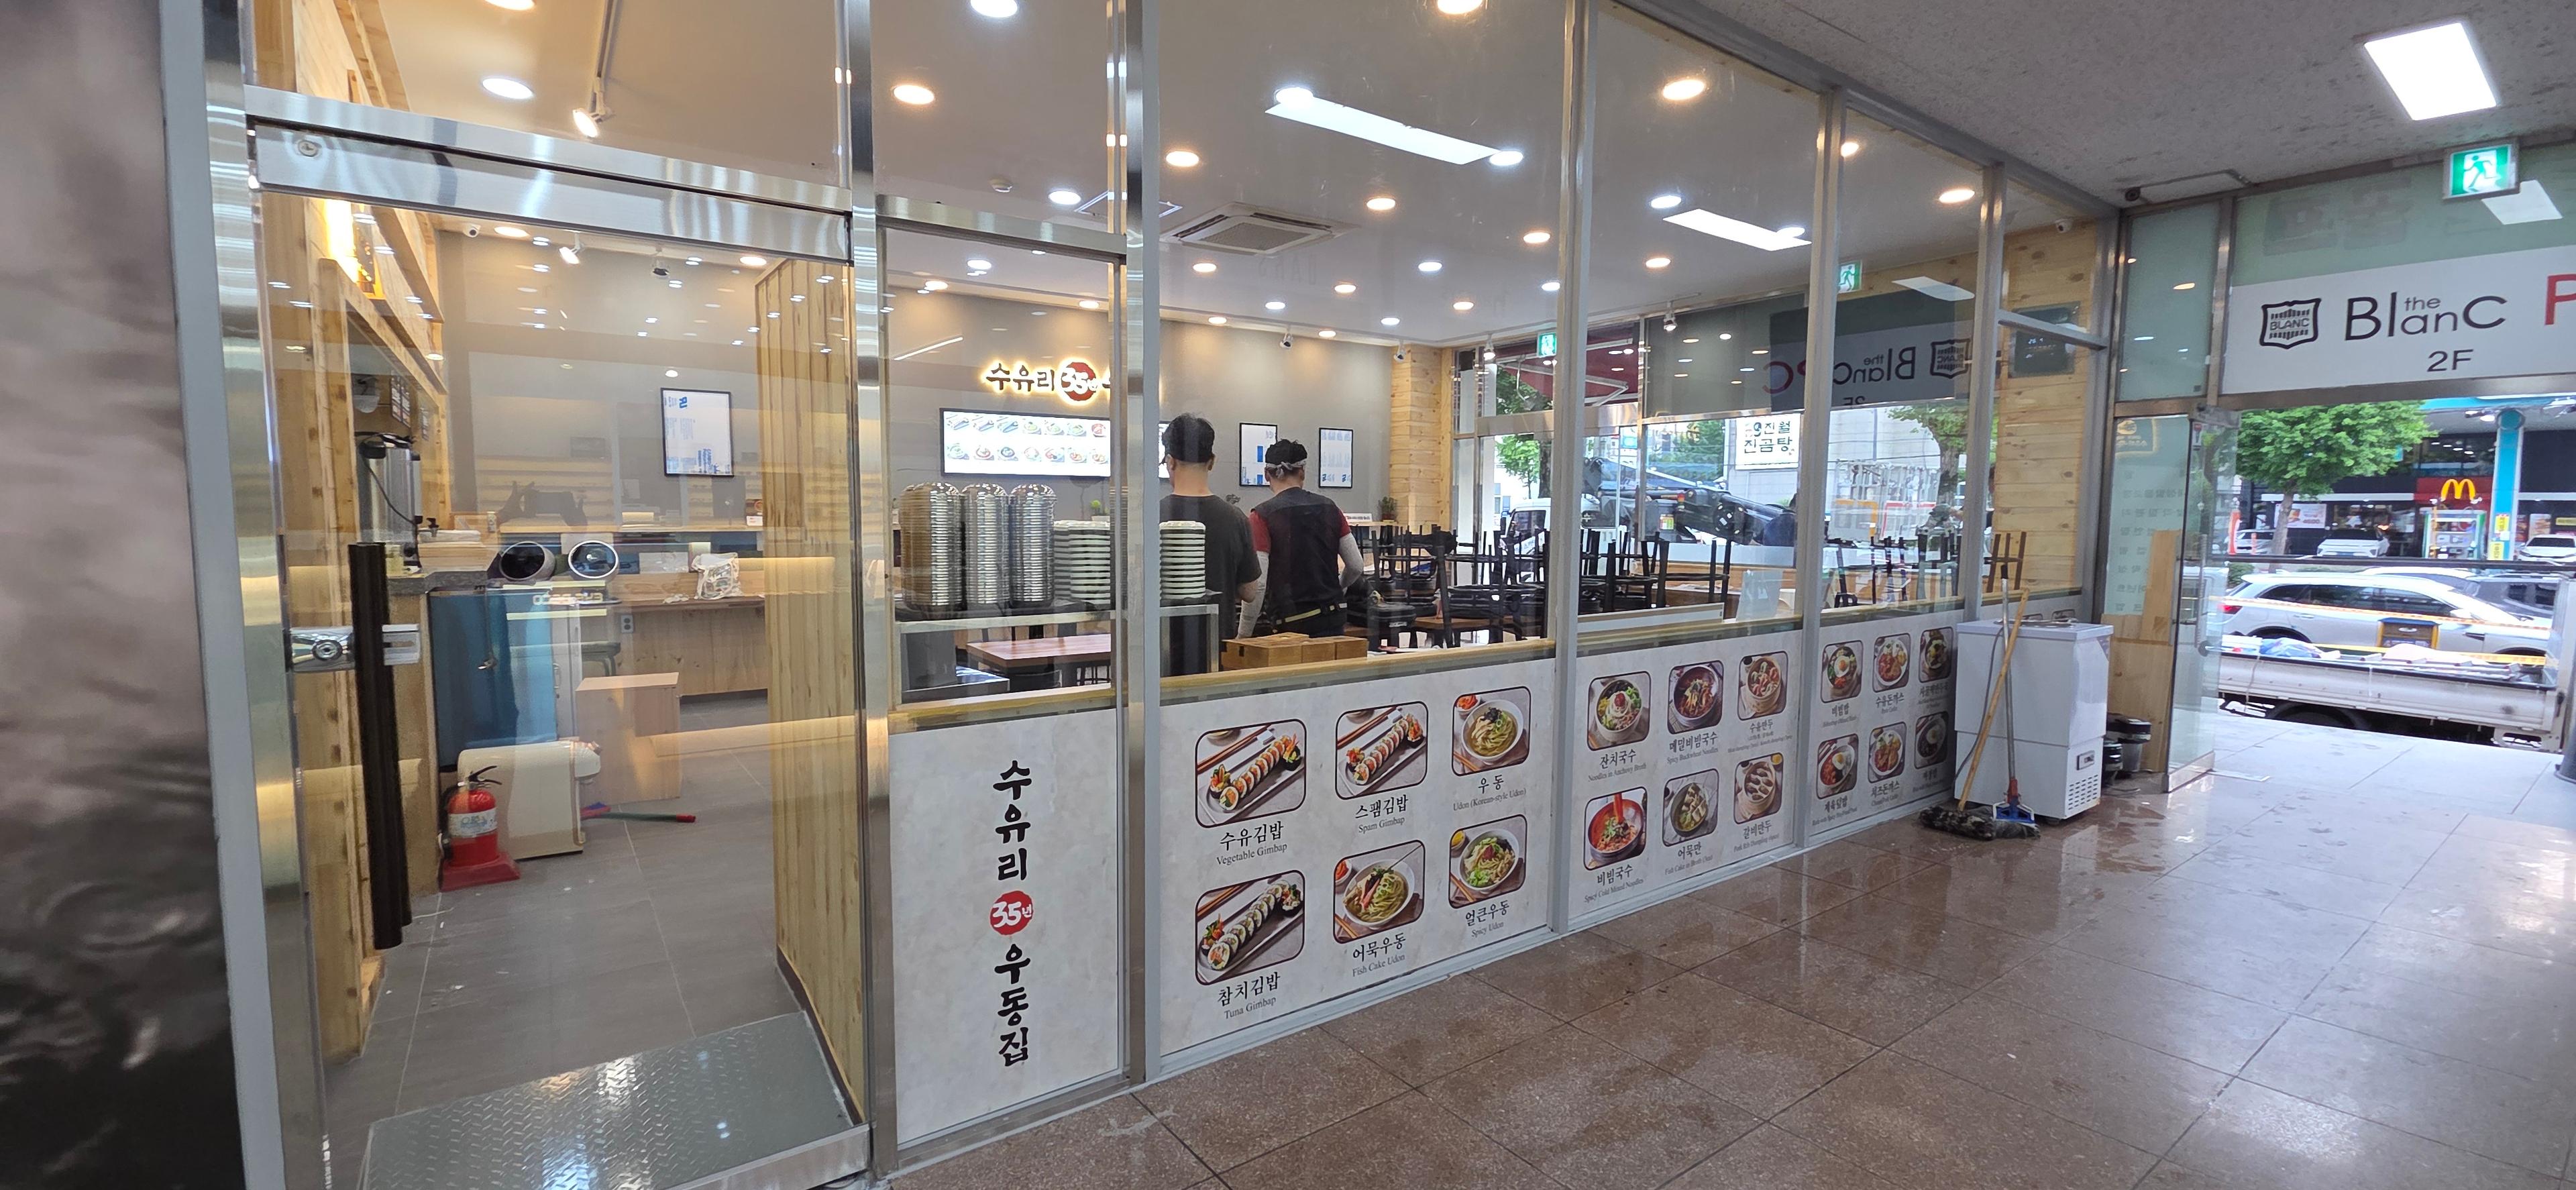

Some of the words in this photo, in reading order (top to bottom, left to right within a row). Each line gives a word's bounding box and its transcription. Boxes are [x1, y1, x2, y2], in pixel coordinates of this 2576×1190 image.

[2404, 296, 2441, 311] the
[2269, 317, 2310, 331] BLANC
[2427, 349, 2474, 372] 2F
[985, 363, 1055, 392] 수유리
[1744, 437, 1793, 453] 진곰탕
[1599, 749, 1637, 769] 잔치국수
[1355, 794, 1408, 818] 스팸김밥
[1453, 802, 1469, 810] Udon
[1509, 788, 1527, 798] Udon)
[993, 760, 1032, 881] 수유리
[1358, 824, 1377, 834] Spam
[1379, 817, 1405, 828] Gimbap
[1220, 820, 1284, 851] 수유김밥
[1216, 850, 1255, 865] Vegetable
[1257, 844, 1287, 856] Gimbap
[1678, 841, 1702, 860] 어묵만
[1597, 864, 1633, 886] 비빔국수
[992, 902, 1034, 928] 35년
[1465, 900, 1509, 926] 얼큰우동
[1471, 928, 1487, 938] Spicy
[1489, 922, 1504, 931] Udon
[1352, 932, 1406, 962] 어묵우동
[1352, 966, 1367, 977] Fish
[1368, 961, 1385, 971] Cake
[1387, 955, 1405, 965] Udon
[1217, 971, 1281, 1007] 참치김밥
[994, 943, 1032, 1068] 우동집
[1224, 1007, 1244, 1019] Tuna
[1246, 997, 1277, 1012] Gimbap
